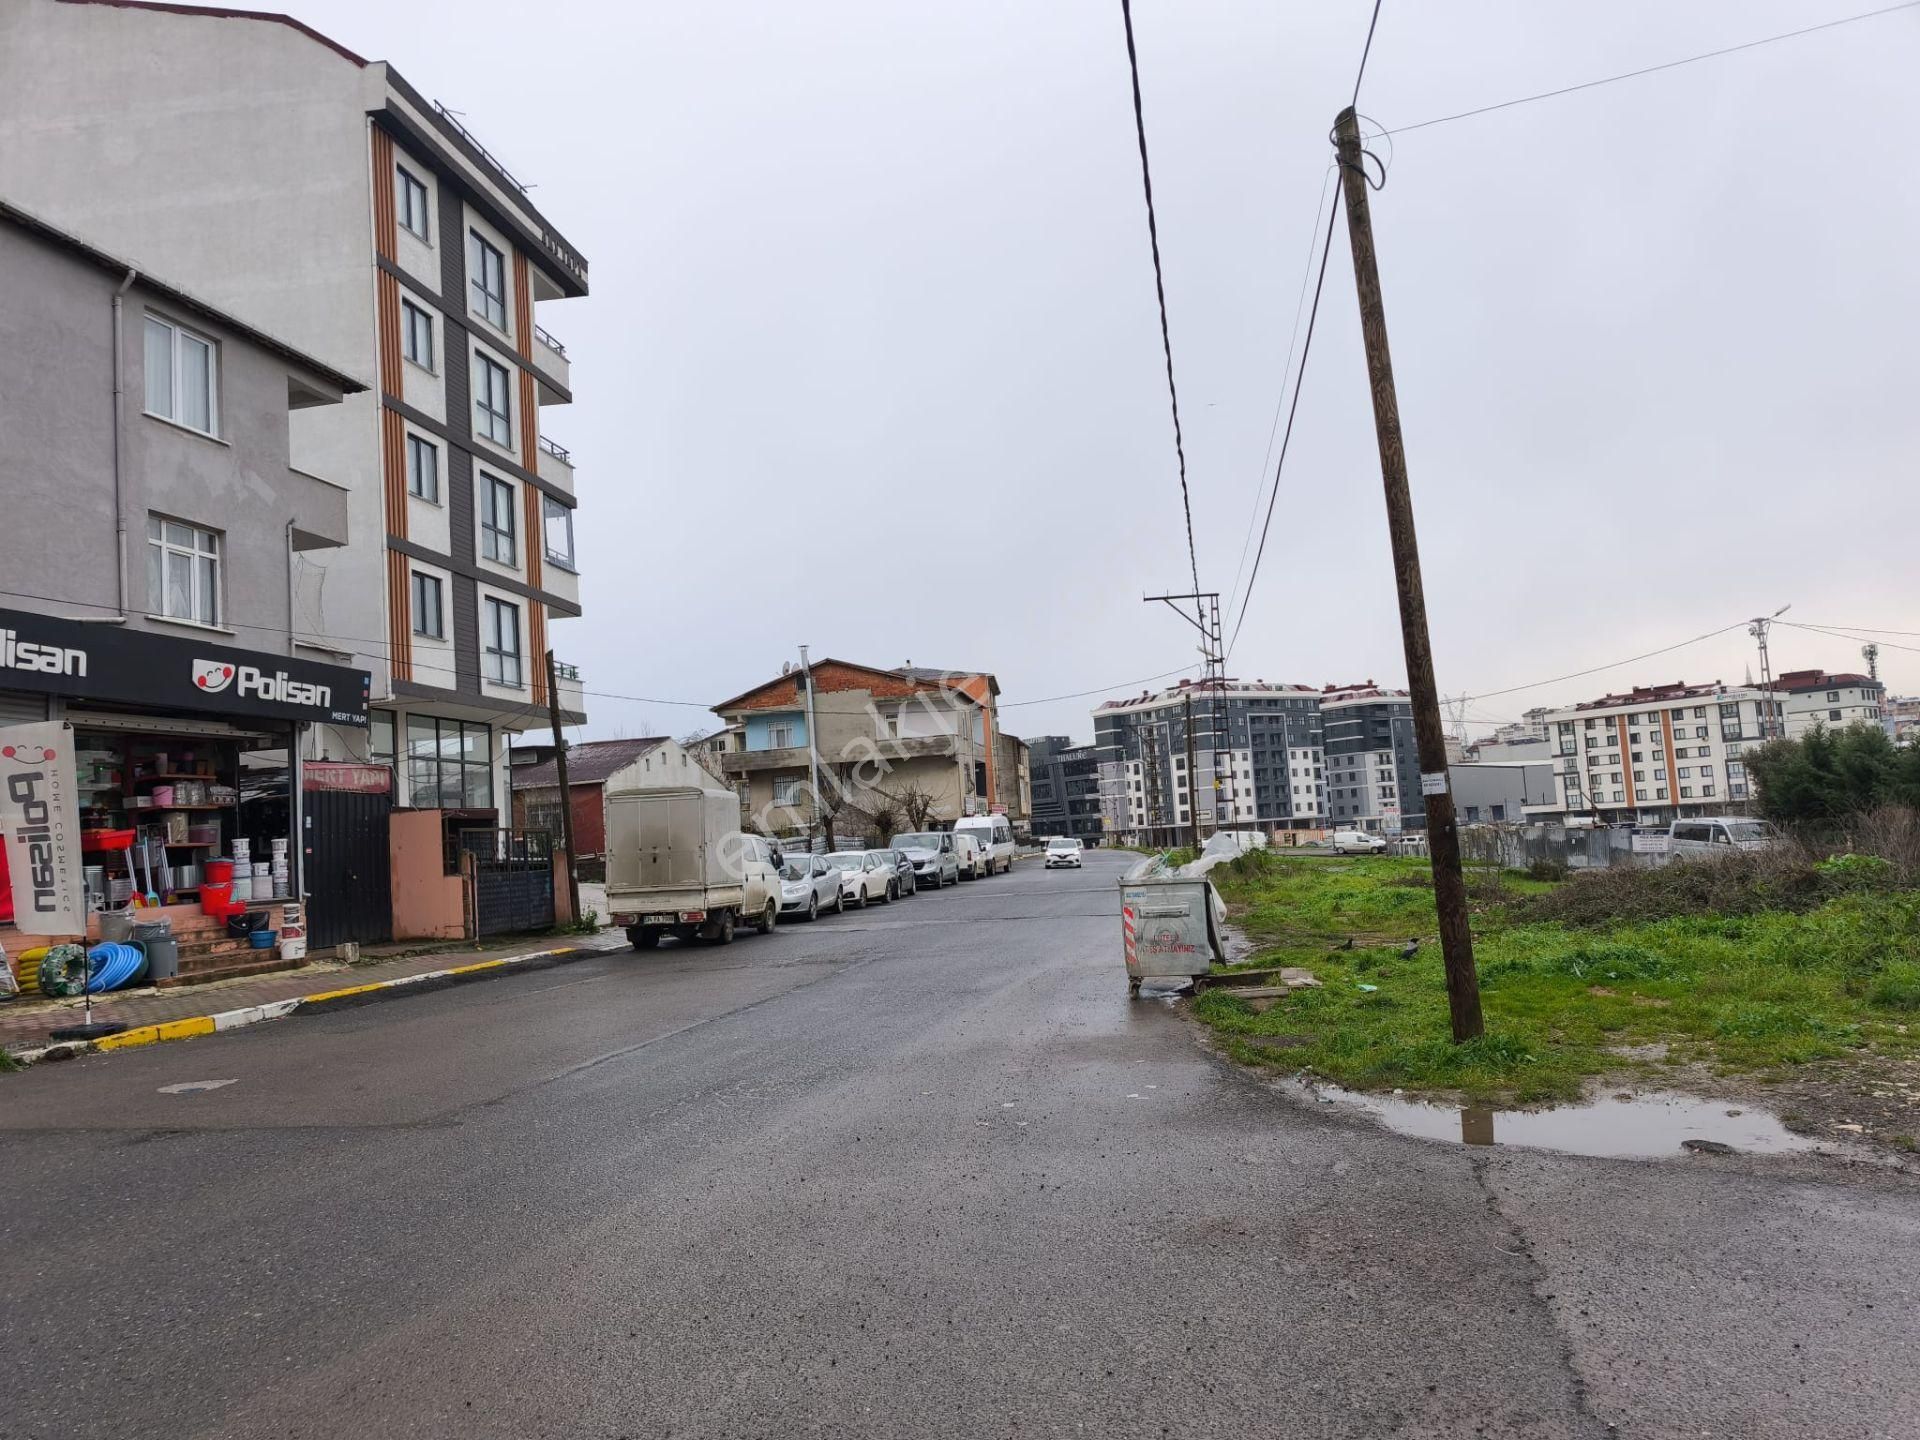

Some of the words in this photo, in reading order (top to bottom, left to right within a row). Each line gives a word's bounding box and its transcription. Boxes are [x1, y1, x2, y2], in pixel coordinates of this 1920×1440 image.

[237, 665, 331, 708] Polisan
[332, 711, 351, 722] MERT
[352, 713, 367, 724] YAPI
